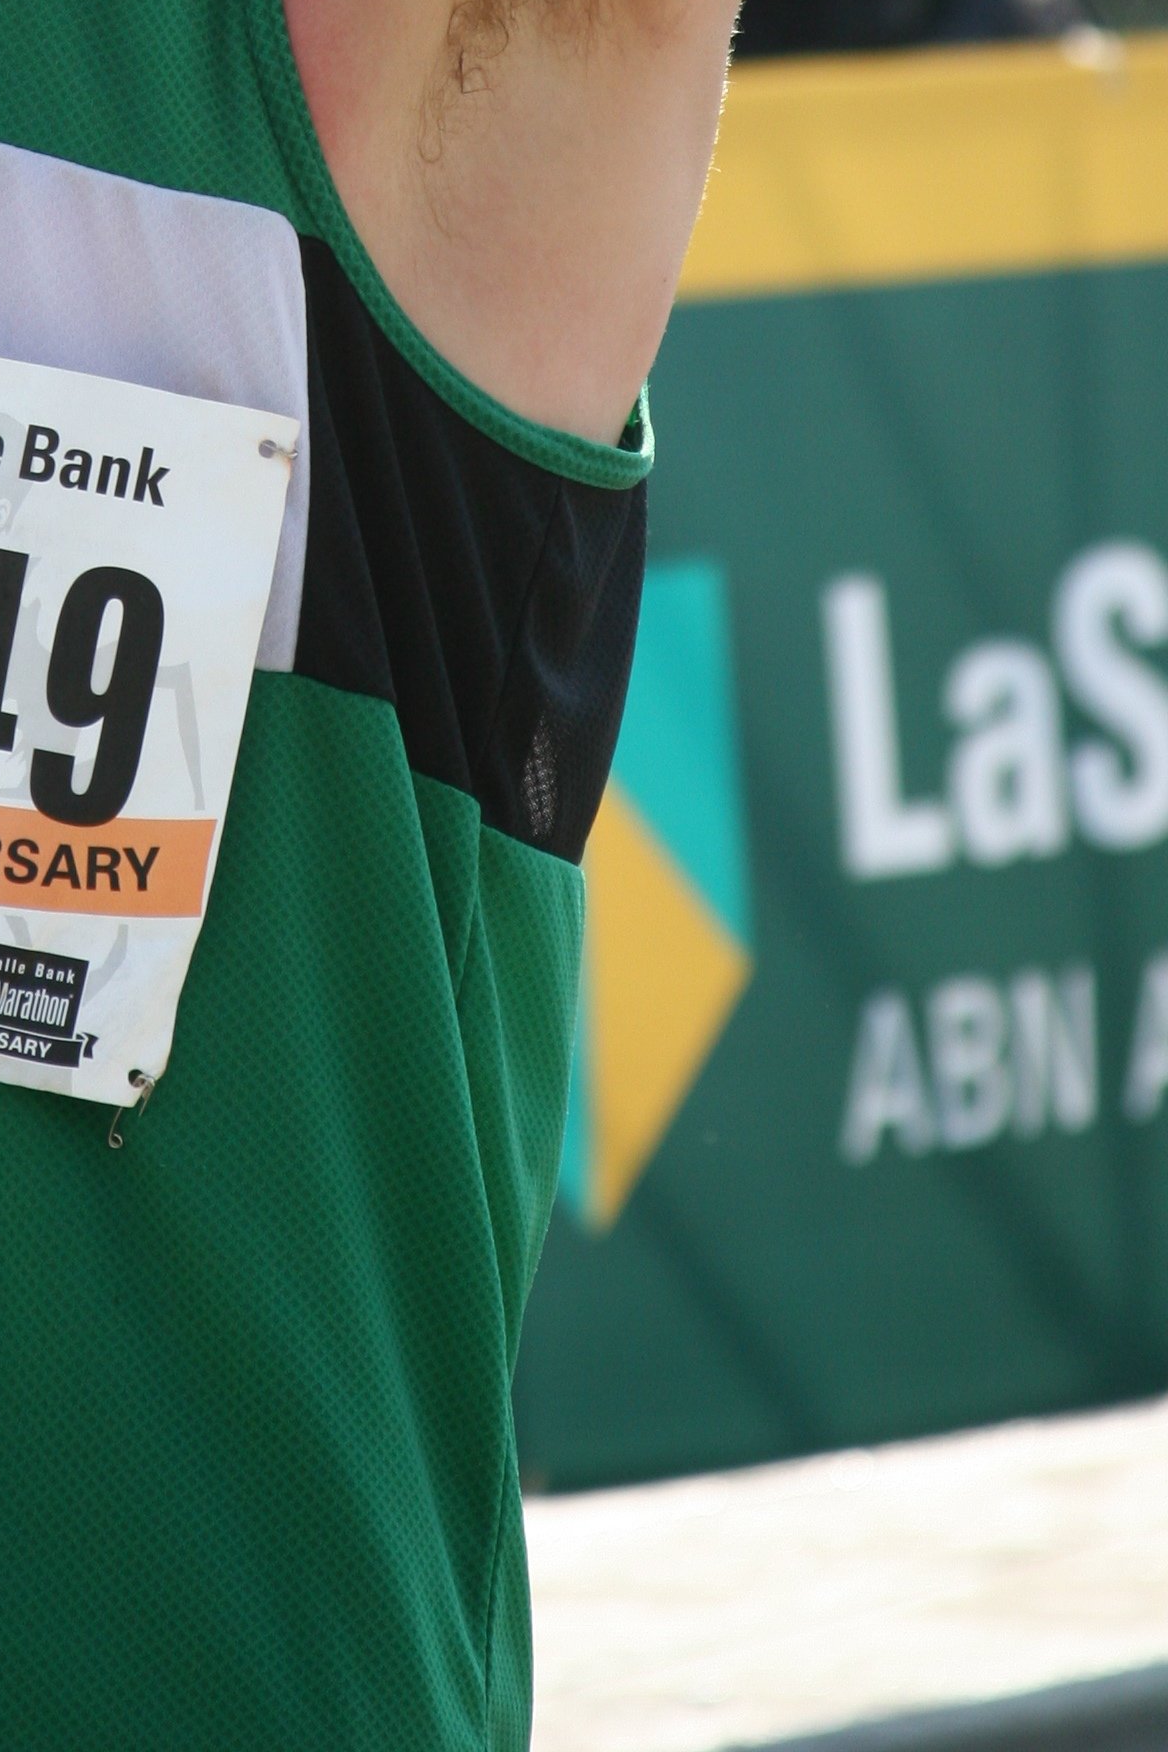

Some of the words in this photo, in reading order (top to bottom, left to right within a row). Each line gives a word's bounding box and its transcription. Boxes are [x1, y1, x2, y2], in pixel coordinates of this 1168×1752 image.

[18, 424, 171, 508] Bank
[35, 963, 76, 985] Bank
[840, 960, 1099, 1165] ABN
